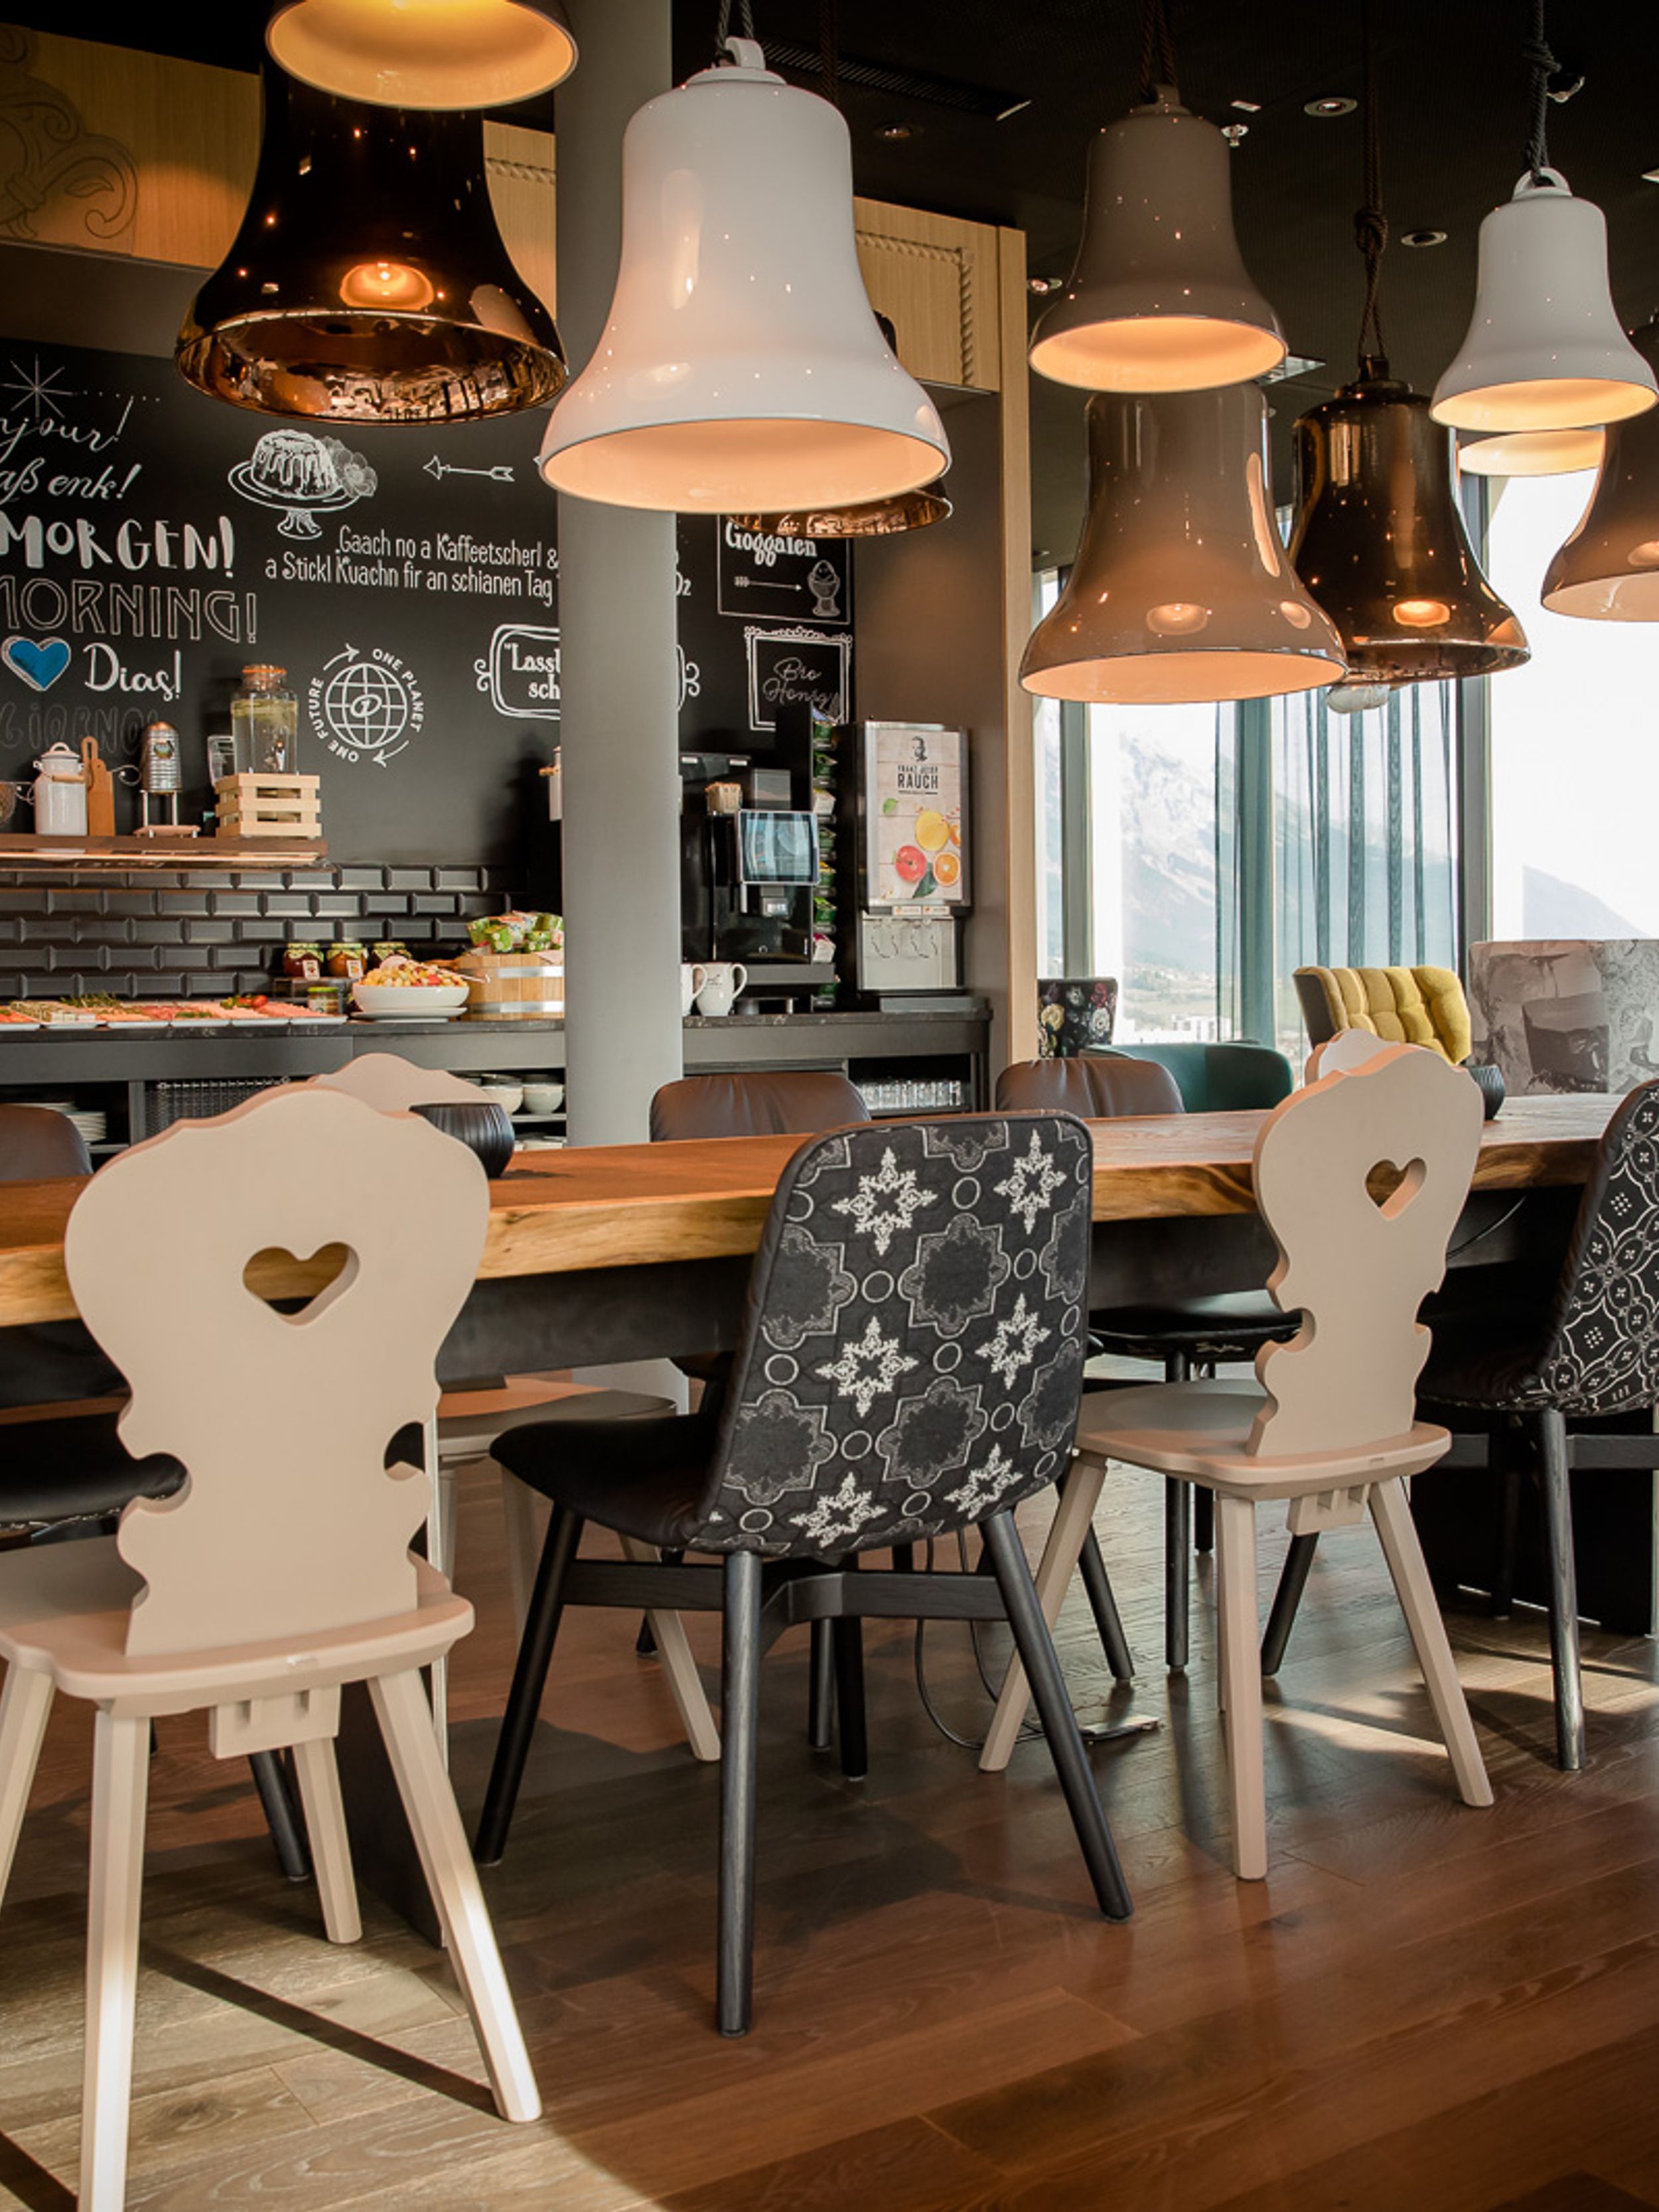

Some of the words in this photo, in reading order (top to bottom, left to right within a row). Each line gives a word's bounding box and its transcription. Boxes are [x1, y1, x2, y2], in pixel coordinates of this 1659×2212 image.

[47, 464, 143, 500] enk!
[396, 537, 416, 559] no
[421, 539, 431, 560] a
[436, 533, 542, 567] Kaffeetscherl
[547, 547, 560, 569] &
[265, 558, 277, 579] a
[282, 551, 331, 583] Stickl
[335, 555, 399, 588] Kuachn
[402, 561, 422, 589] fir
[426, 569, 448, 592] an
[451, 565, 522, 596] schianen
[524, 569, 553, 608] Tag
[82, 642, 182, 702] Dias!
[372, 648, 403, 671] ONE
[401, 670, 424, 732] PLANET
[308, 677, 329, 740] FUTURE
[327, 739, 360, 762] ONE
[898, 773, 938, 789] RAUCH
